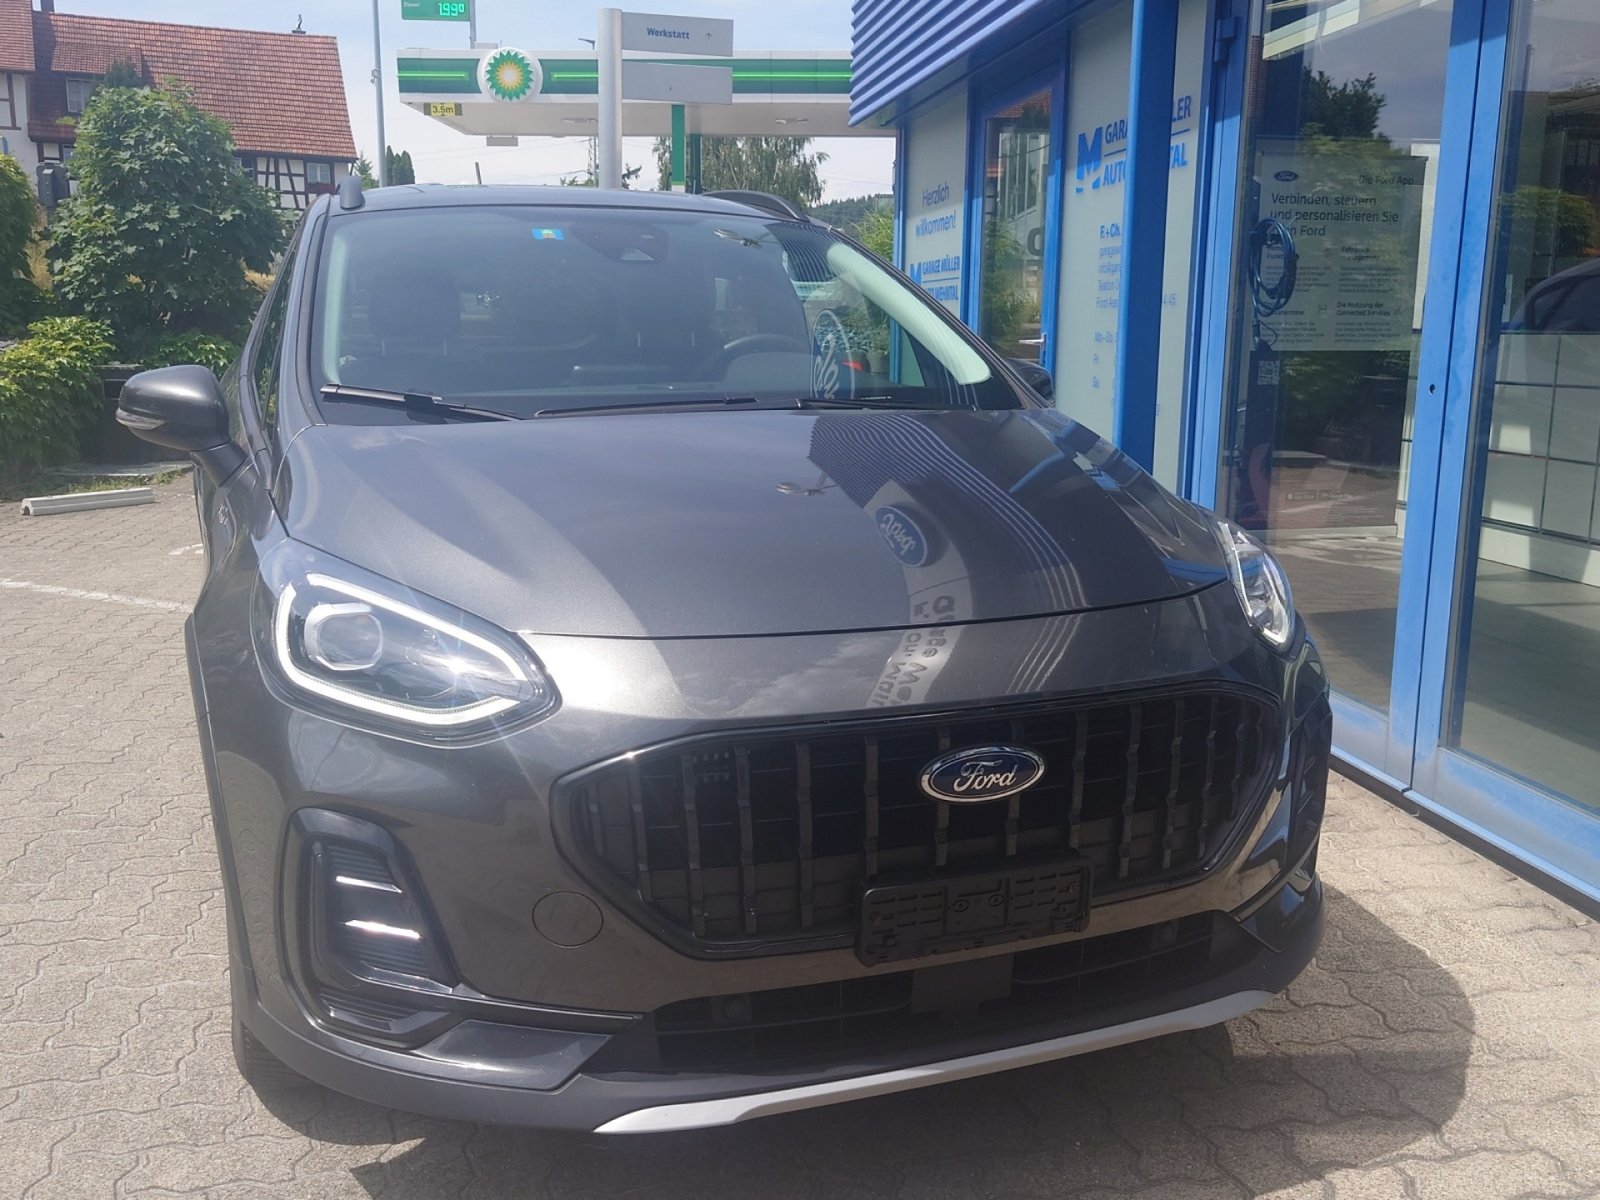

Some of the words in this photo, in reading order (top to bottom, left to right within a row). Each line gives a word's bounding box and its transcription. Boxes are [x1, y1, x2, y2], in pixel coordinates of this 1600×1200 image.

[646, 27, 690, 40] Werkstatt
[432, 104, 454, 115] 3.5m
[922, 181, 950, 208] Herzlich
[1271, 193, 1331, 207] Verbinden,
[1334, 195, 1377, 206] steuern
[915, 209, 956, 237] willkommen!
[1382, 211, 1399, 222] Sie
[1300, 225, 1326, 236] Ford
[922, 258, 941, 275] GARAGE
[941, 253, 960, 272] MÜLLER
[953, 759, 1019, 792] Ford
